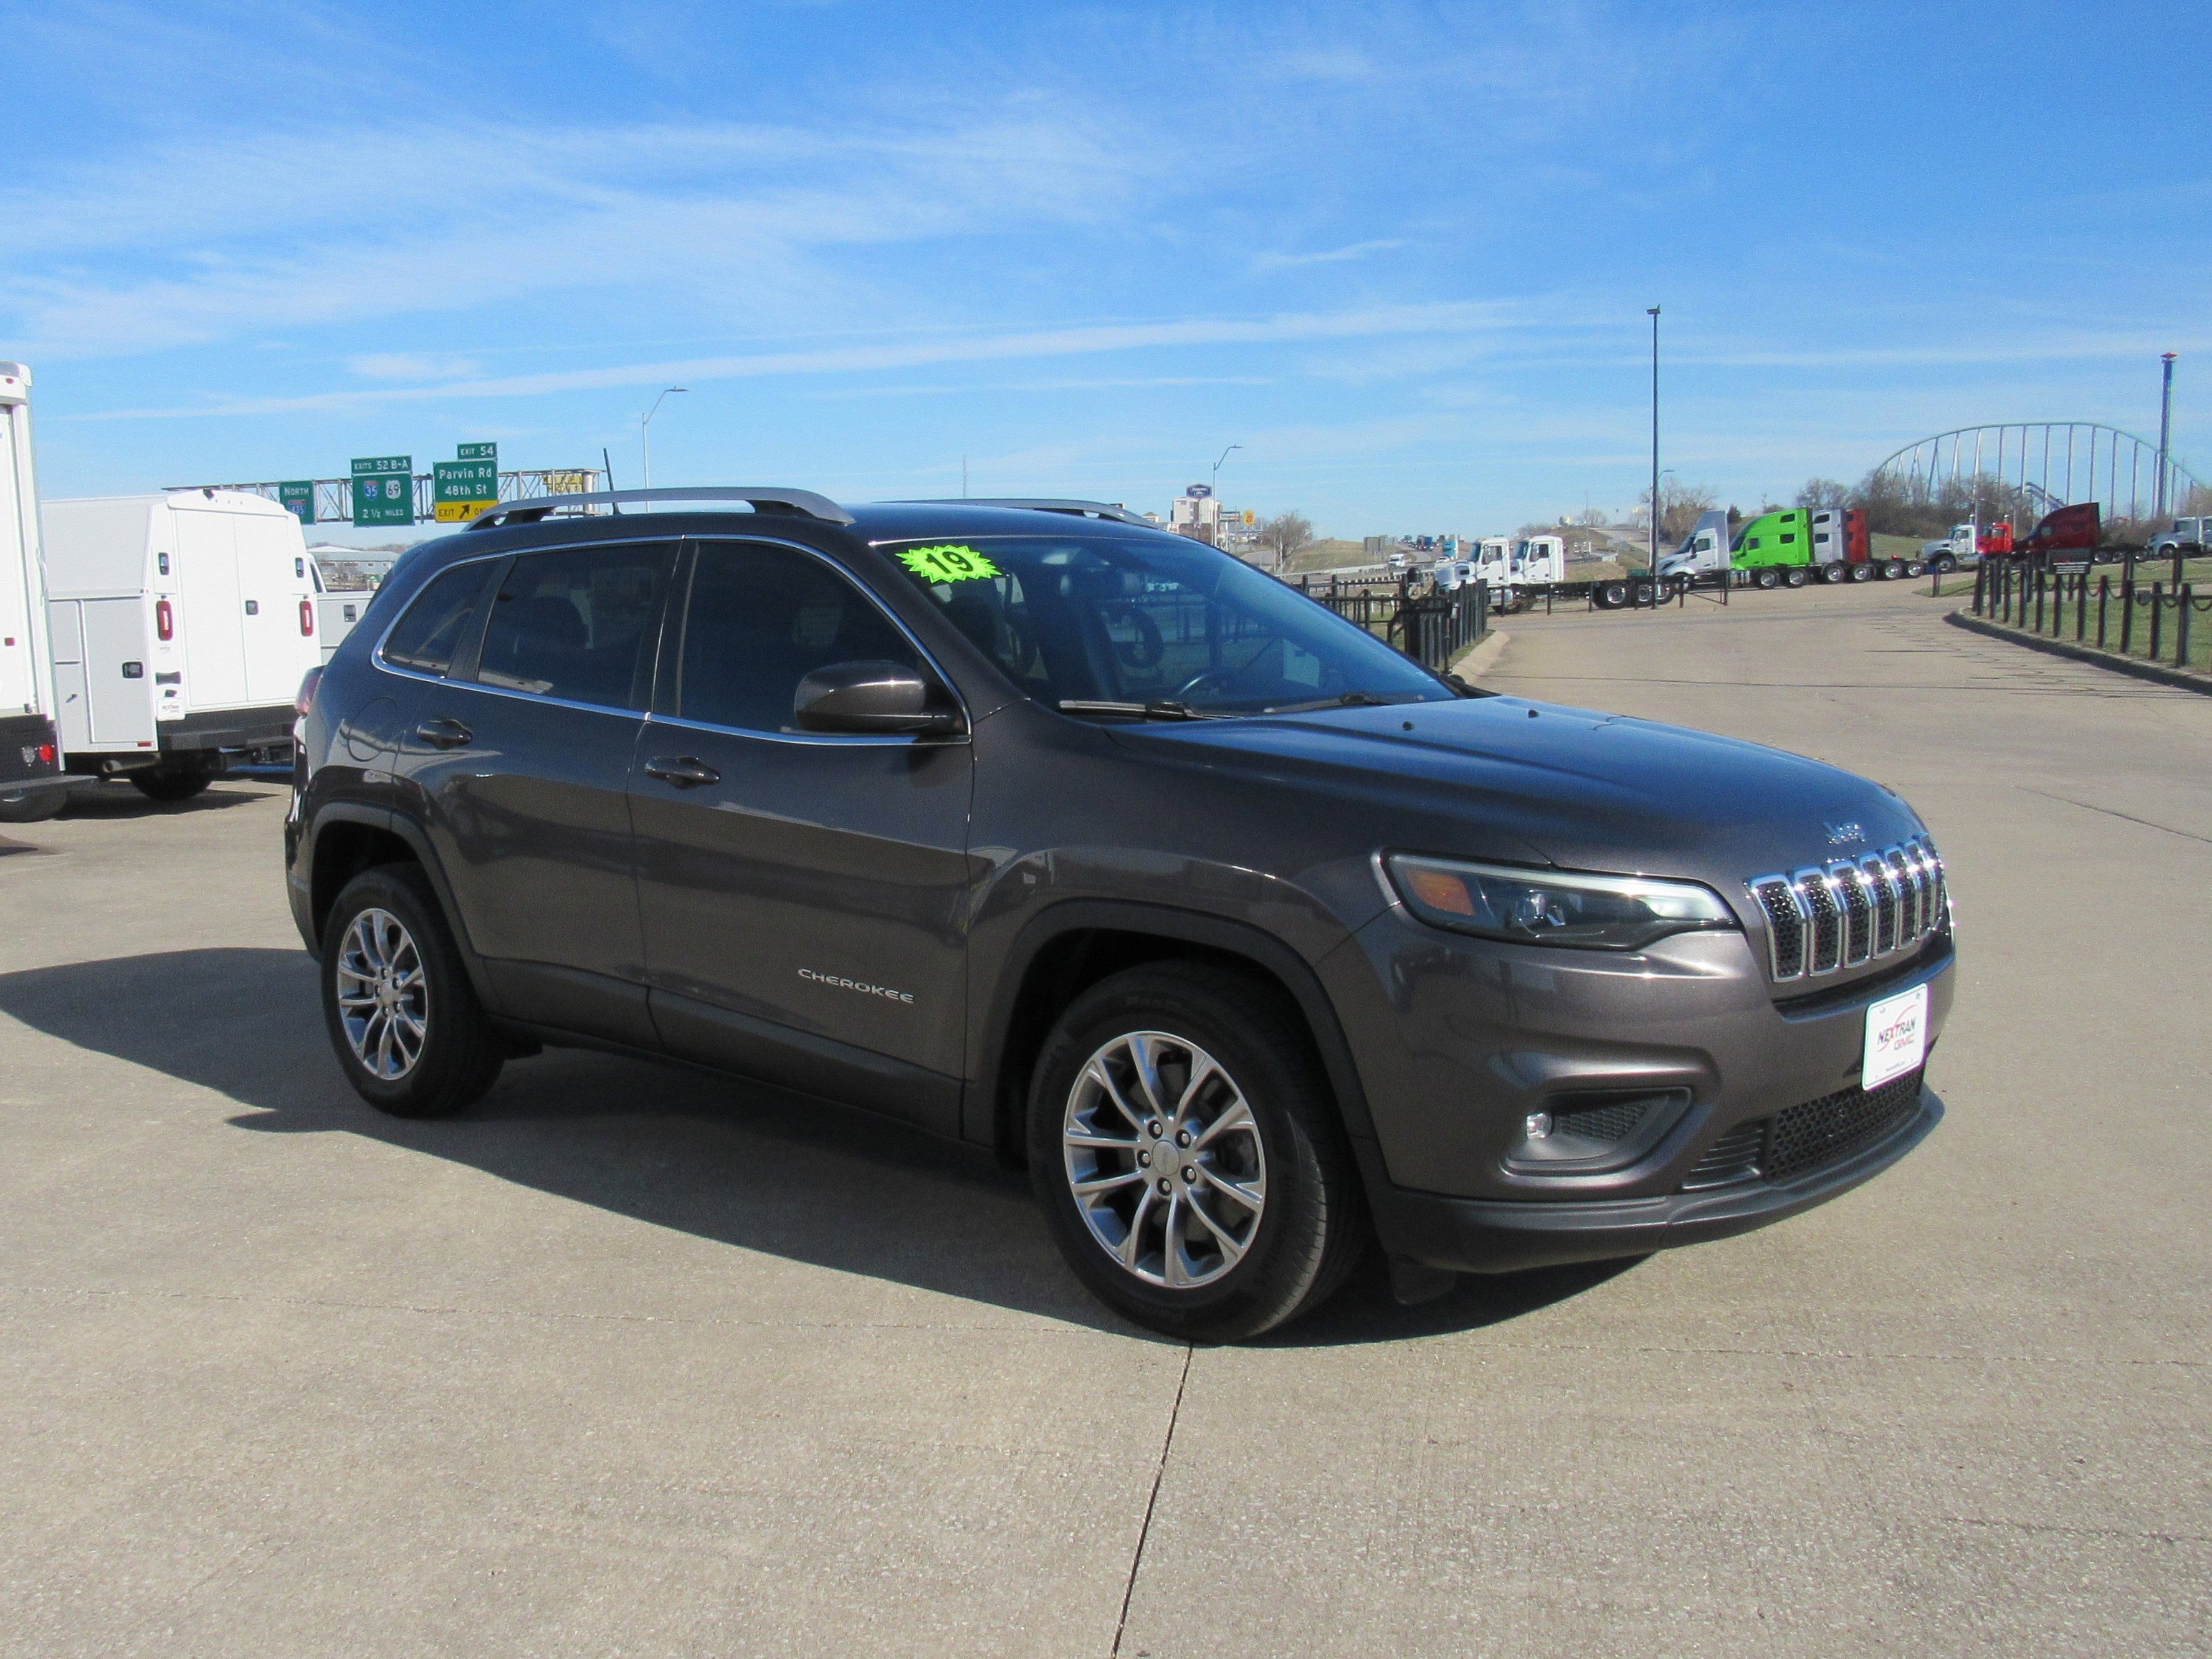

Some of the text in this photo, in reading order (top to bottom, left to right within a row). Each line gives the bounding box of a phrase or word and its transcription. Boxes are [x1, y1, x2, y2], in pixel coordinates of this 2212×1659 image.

[480, 446, 493, 456] 54
[354, 460, 409, 471] EXITS 52 B-A
[439, 467, 492, 479] Parvin Rd
[284, 487, 310, 496] NORTH
[365, 484, 399, 497] 35 69
[445, 484, 487, 495] 48th St
[363, 509, 369, 519] 2
[438, 508, 455, 517] EXIT
[926, 551, 974, 574] 19
[798, 968, 915, 1004] CHEROKEE
[1877, 1016, 1917, 1046] NEXTRAN
[1894, 1033, 1915, 1051] GMC
